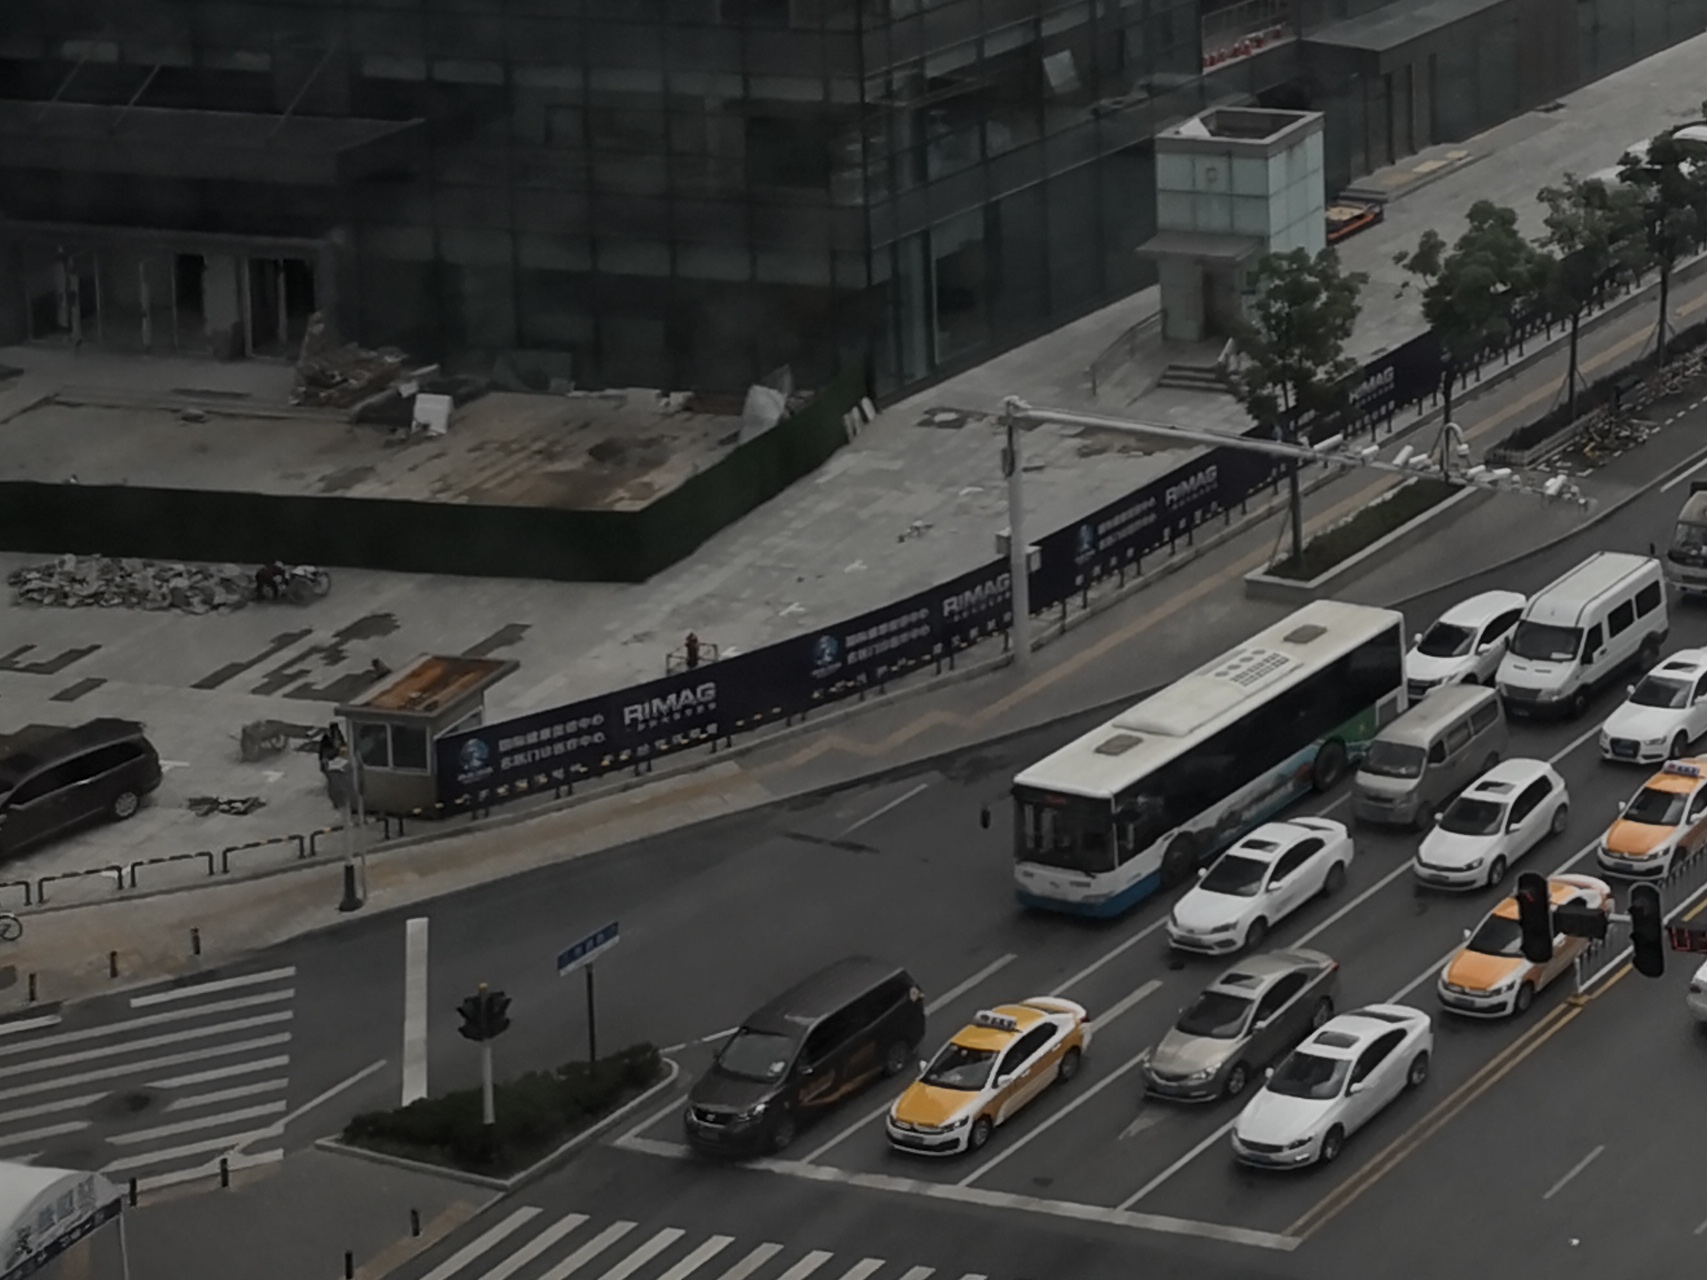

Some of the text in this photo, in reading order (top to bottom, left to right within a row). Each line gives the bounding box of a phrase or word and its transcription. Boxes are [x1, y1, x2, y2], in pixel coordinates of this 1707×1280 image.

[1164, 464, 1218, 508] RIMAG
[942, 572, 1010, 618] RIMAG
[623, 681, 717, 726] RIMAG
